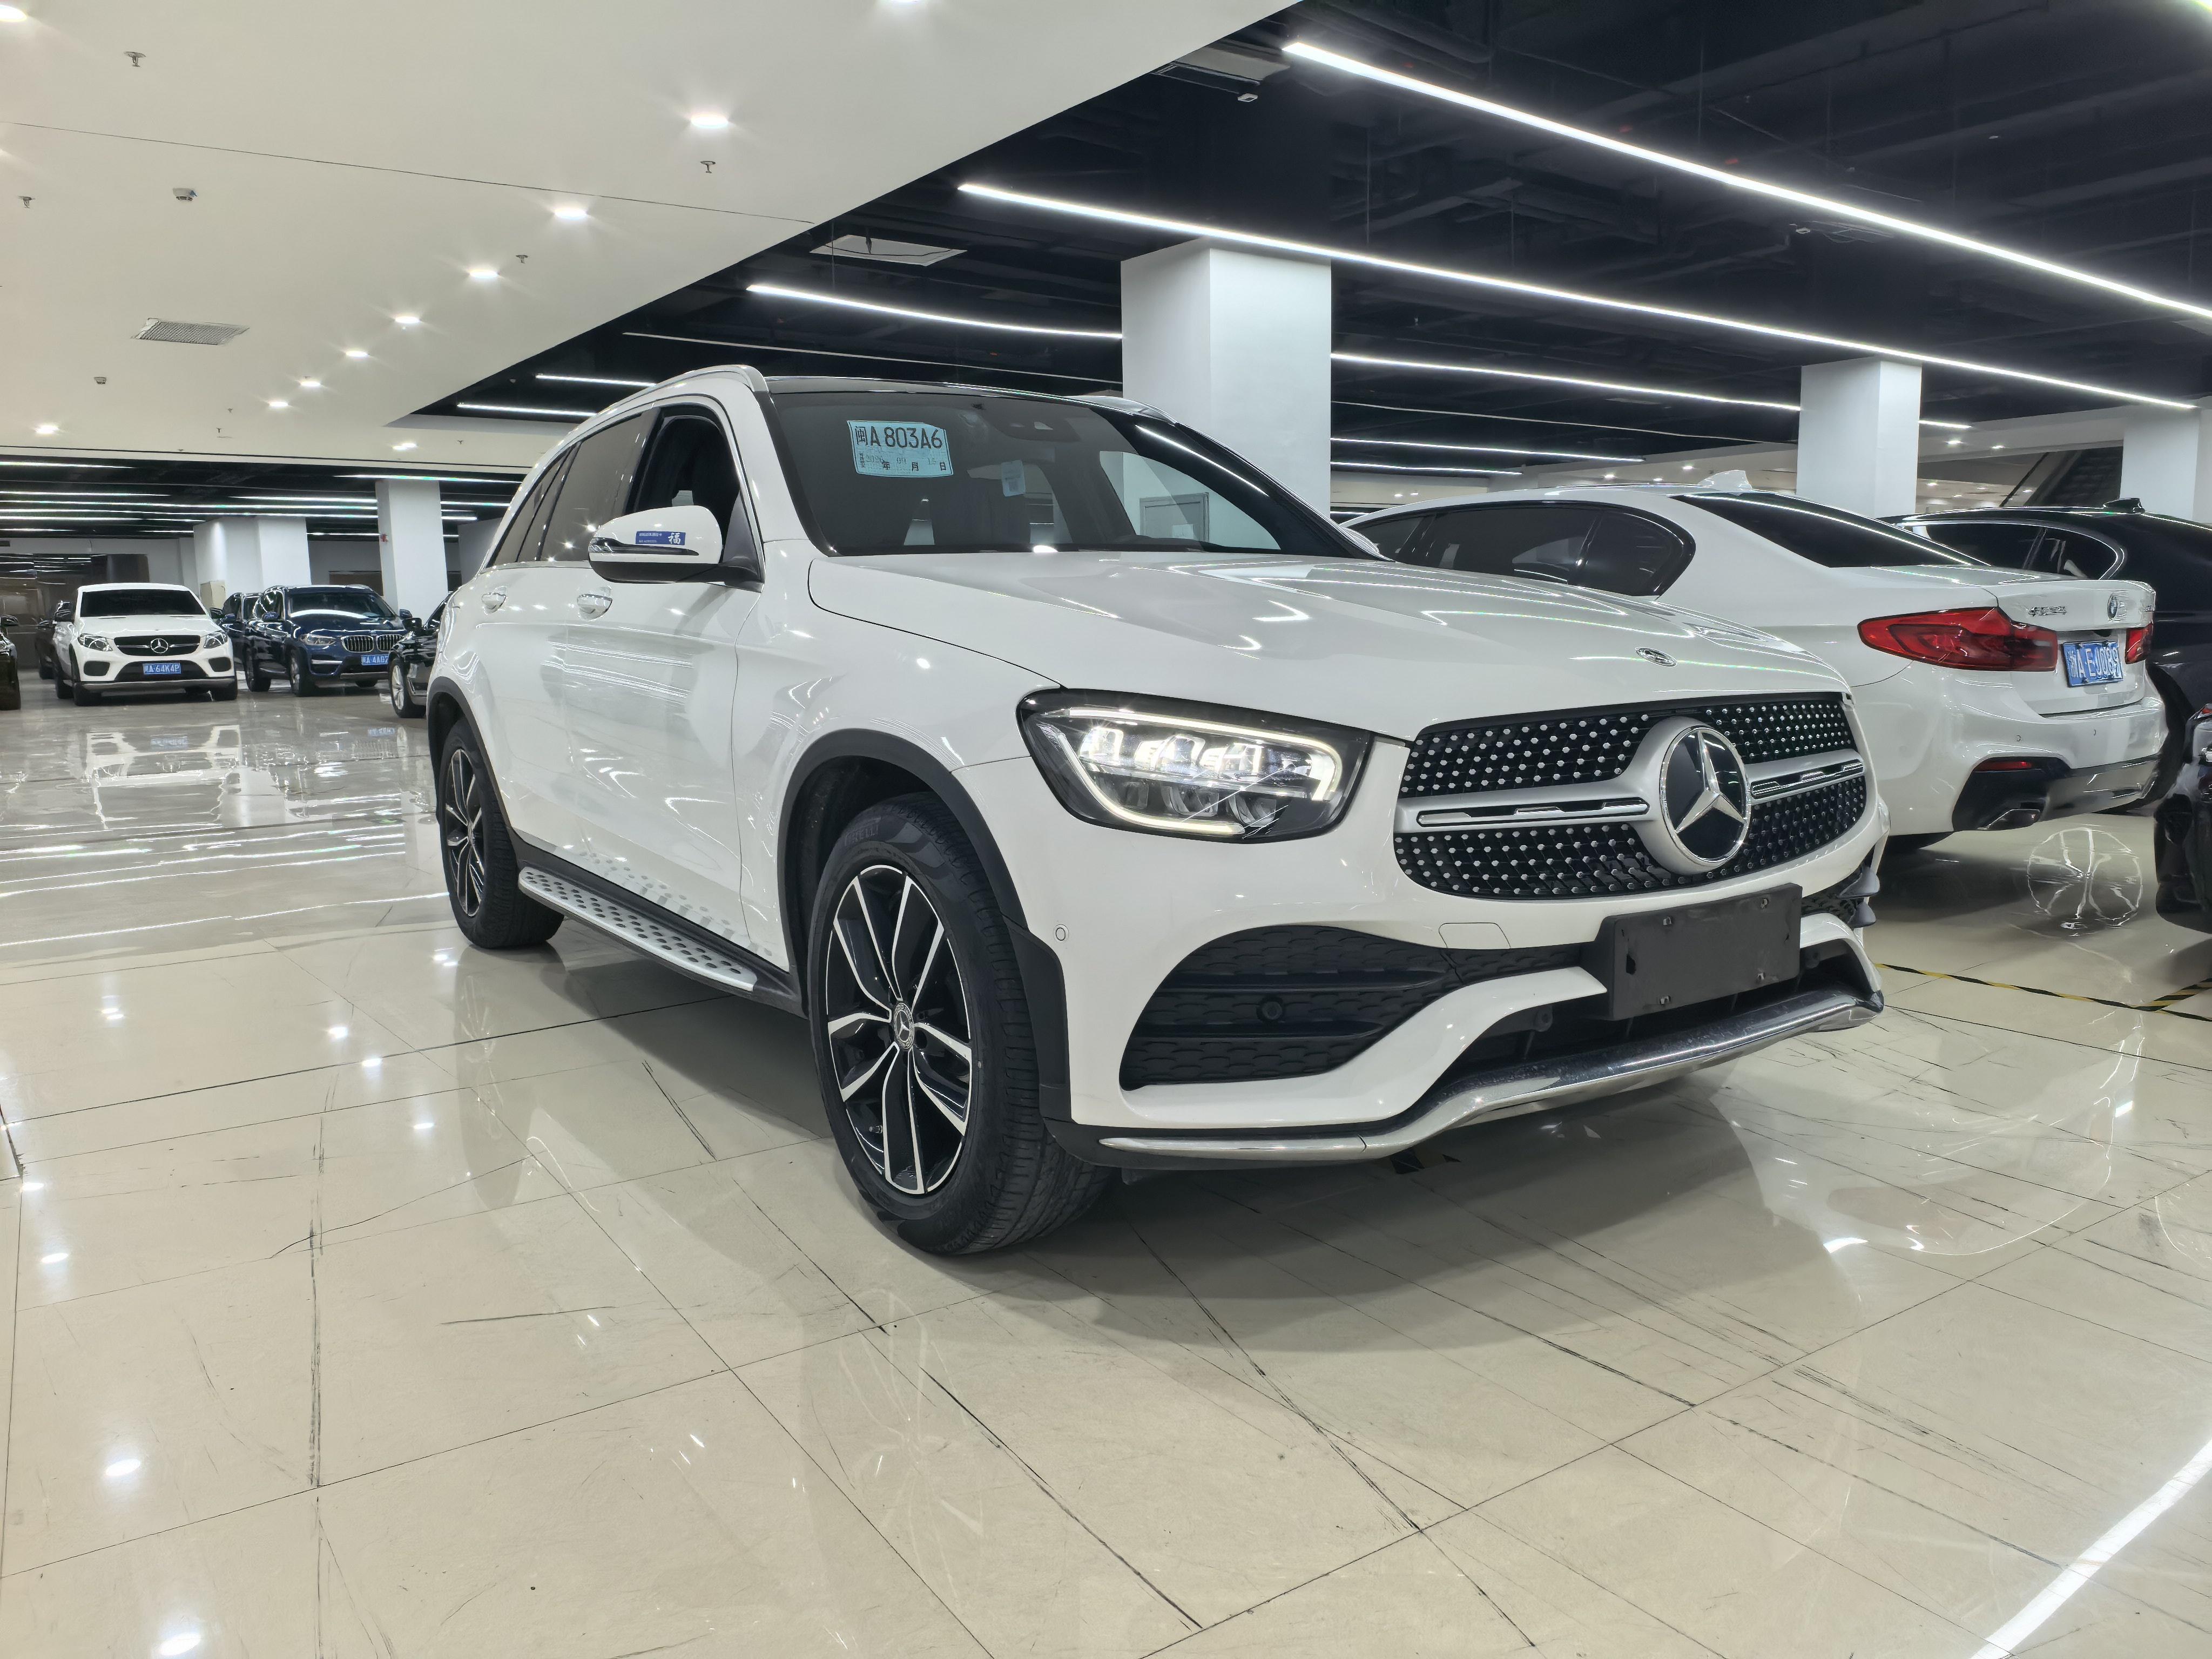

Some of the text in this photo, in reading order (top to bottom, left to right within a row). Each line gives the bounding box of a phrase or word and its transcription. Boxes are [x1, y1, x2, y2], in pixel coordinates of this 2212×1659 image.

[912, 462, 919, 471] 月
[940, 462, 946, 471] 日
[668, 532, 681, 545] 福
